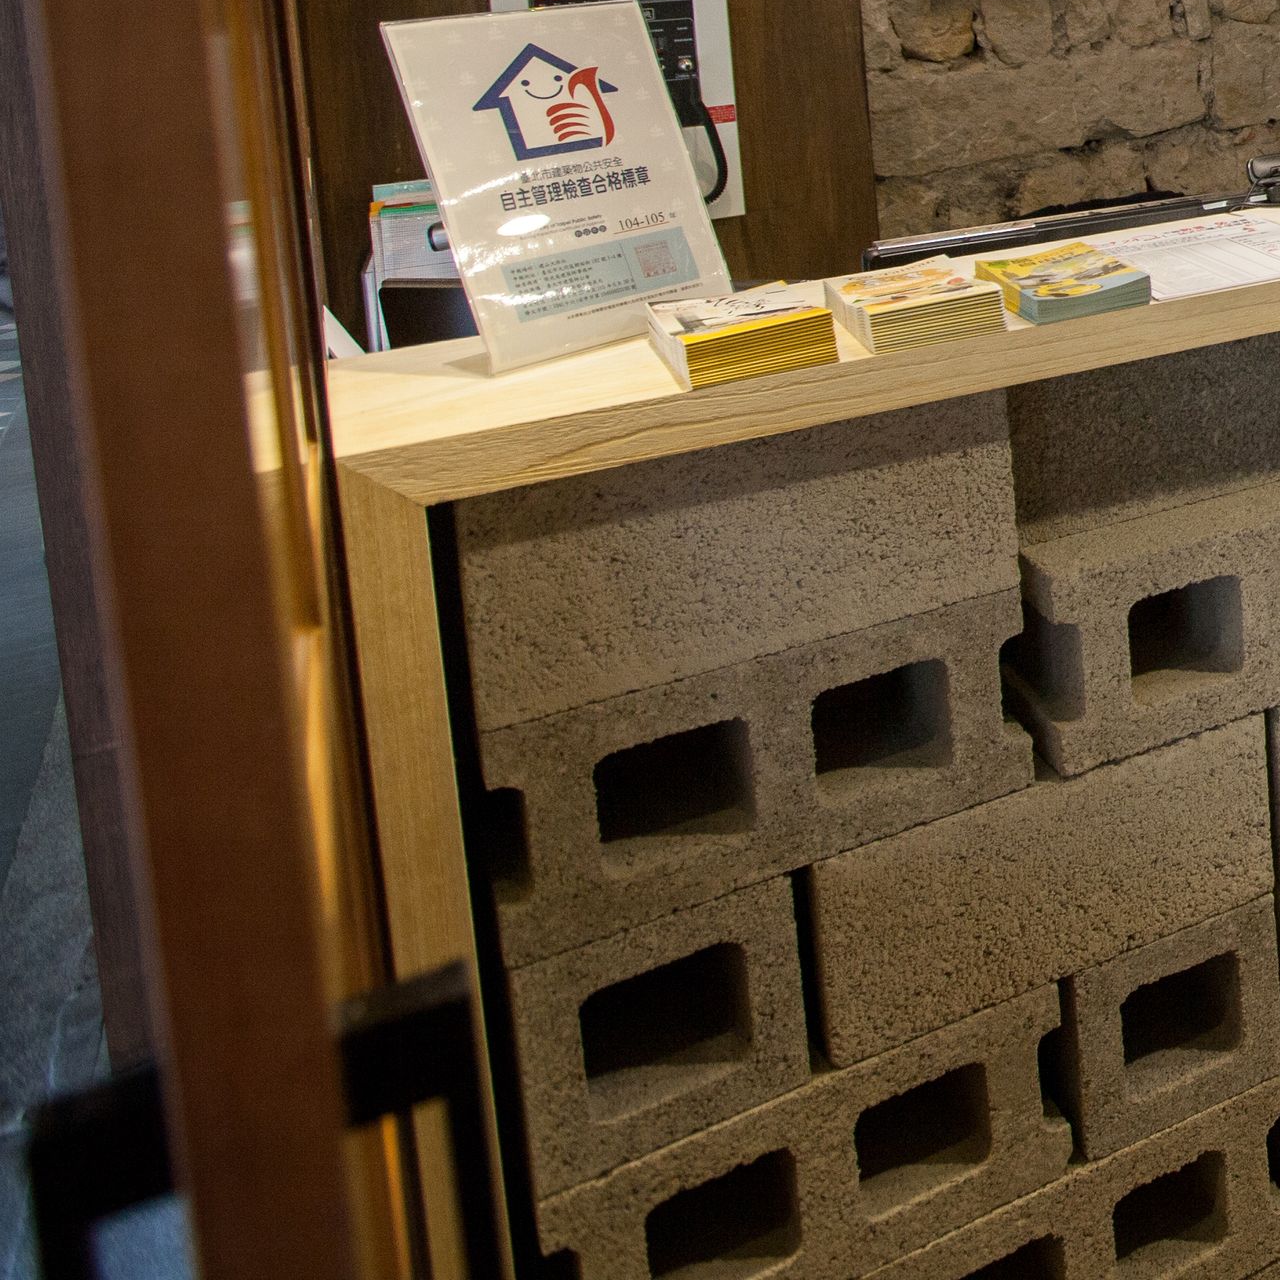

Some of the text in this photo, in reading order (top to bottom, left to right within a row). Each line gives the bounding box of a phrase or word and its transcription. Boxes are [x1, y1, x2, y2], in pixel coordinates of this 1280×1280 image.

[500, 166, 651, 211] 自主管理檢查合格標章
[618, 211, 666, 231] 104-105
